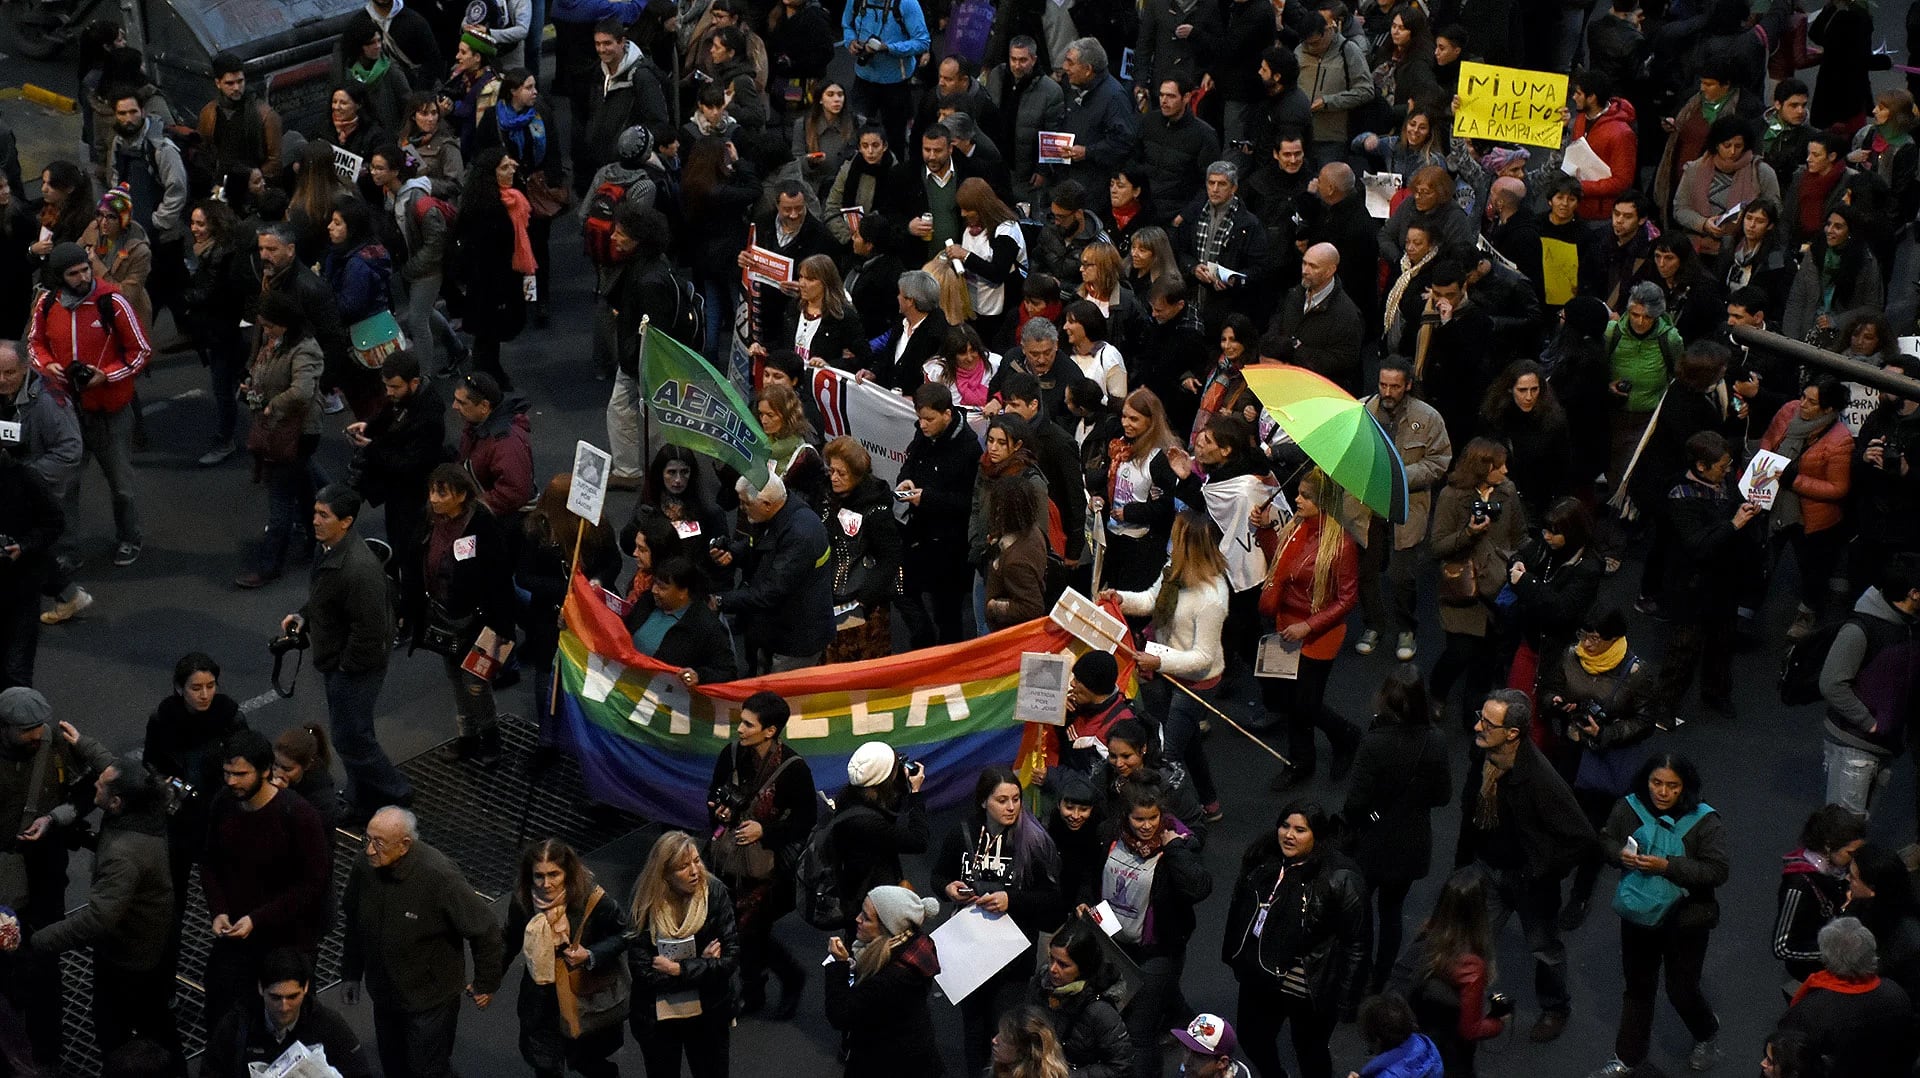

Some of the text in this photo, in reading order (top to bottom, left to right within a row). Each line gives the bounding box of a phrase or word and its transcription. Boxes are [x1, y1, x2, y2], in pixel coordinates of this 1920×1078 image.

[1457, 116, 1479, 136] LA
[652, 379, 758, 445] AEFIP
[665, 412, 738, 448] CAPITAL
